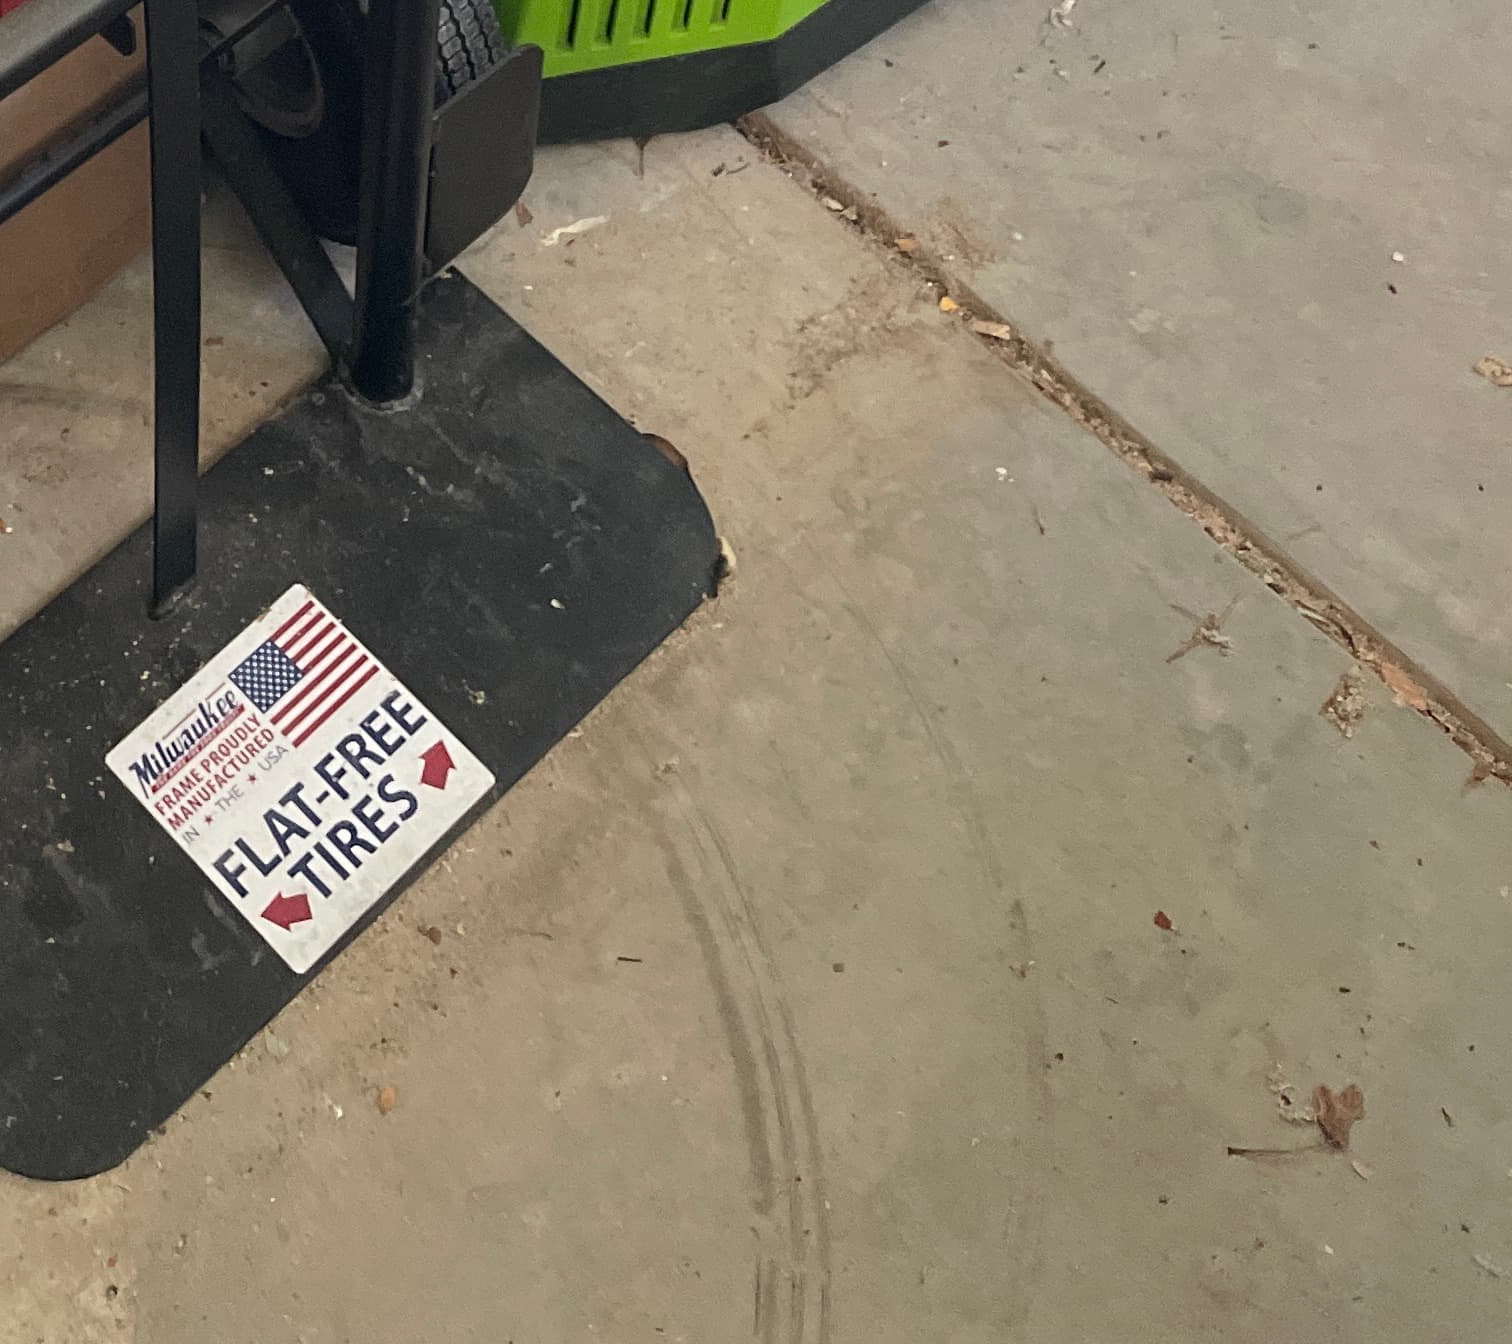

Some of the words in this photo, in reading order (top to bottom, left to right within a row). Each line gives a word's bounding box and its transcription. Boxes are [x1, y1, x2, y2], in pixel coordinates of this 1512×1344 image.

[128, 689, 238, 799] Milwaukee
[153, 767, 204, 816] FRAME
[200, 713, 261, 773] PROUDLY
[167, 728, 275, 831] MANUFACTURED
[181, 824, 201, 845] IN
[214, 784, 244, 812] THE
[257, 745, 289, 772] USA
[212, 689, 429, 898] FLAT-FREE
[287, 773, 419, 899] TIRES
